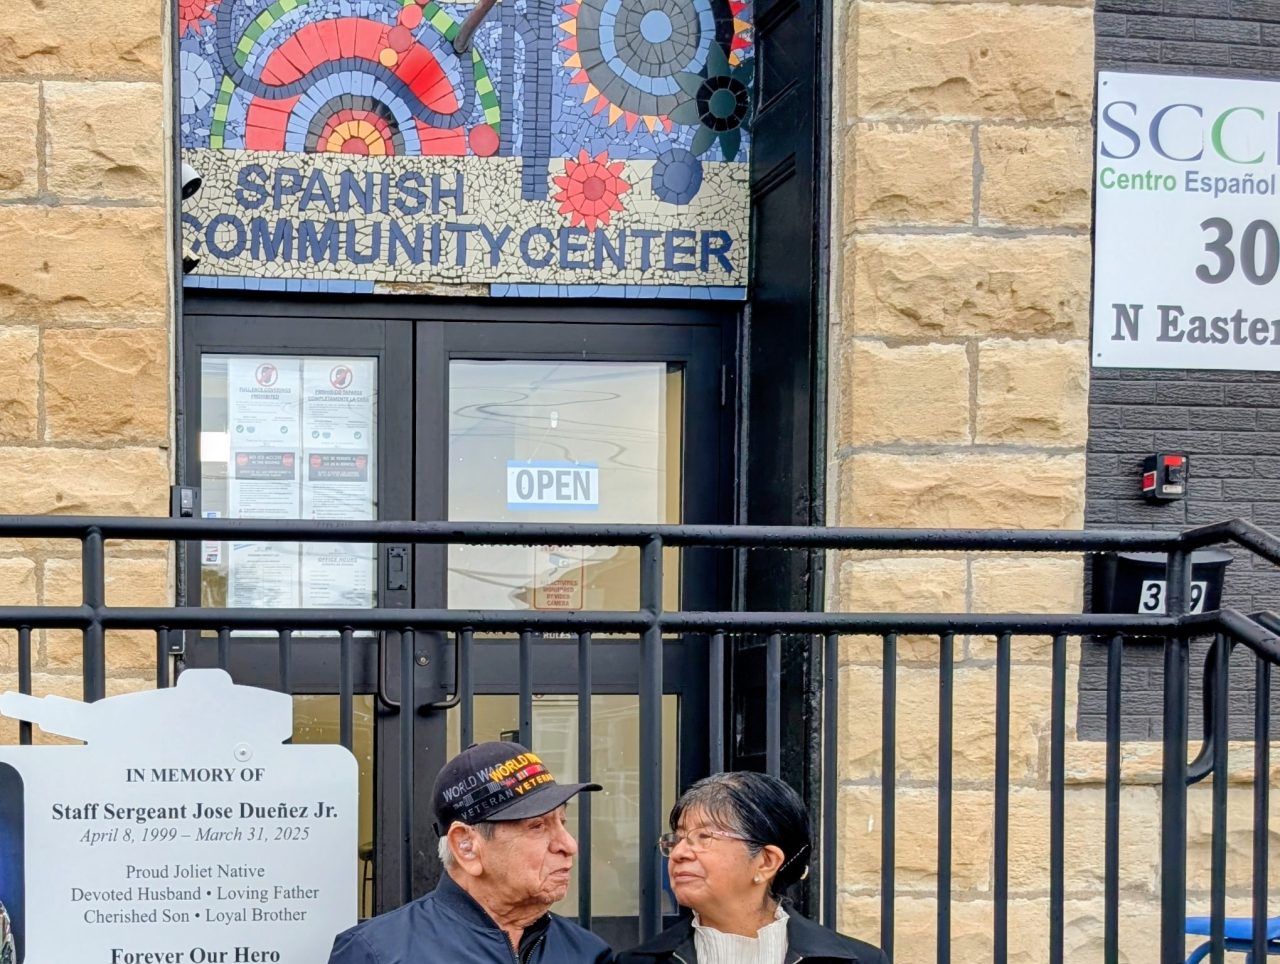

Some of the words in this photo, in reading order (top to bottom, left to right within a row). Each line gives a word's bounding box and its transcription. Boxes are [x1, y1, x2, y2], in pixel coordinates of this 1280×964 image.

[1100, 101, 1266, 164] SCC
[235, 164, 464, 216] SPANISH
[1099, 167, 1177, 191] Centro
[1185, 170, 1277, 198] Español
[520, 227, 734, 274] CENTER
[1111, 303, 1144, 341] N
[515, 469, 591, 501] OPEN
[1143, 583, 1203, 611] 39
[126, 768, 146, 782] IN
[150, 768, 236, 782] MEMORY
[240, 768, 266, 782] OF
[489, 754, 529, 783] WORLD
[442, 775, 477, 803] WORLD
[52, 803, 99, 820] Staff
[103, 803, 187, 824] Sergeant
[192, 803, 233, 819] Jose
[239, 802, 308, 819] Dueñez
[314, 801, 338, 818] Jr.
[461, 789, 514, 820] VETERAN
[79, 828, 119, 846] April
[122, 828, 135, 844] 8,
[142, 827, 177, 841] 1999
[194, 827, 242, 841] March
[247, 827, 268, 842] 31,
[274, 827, 310, 841] 2025
[126, 865, 169, 879] Proud
[173, 864, 213, 879] Joliet
[217, 864, 265, 878] Native
[71, 887, 133, 902] Devoted
[137, 886, 201, 901] Husband
[217, 885, 269, 904] Loving
[273, 885, 320, 899] Father
[83, 909, 157, 923] Cherished
[162, 908, 190, 922] Son
[205, 908, 247, 925] Loyal
[252, 907, 307, 921] Brother
[110, 948, 184, 964] Forever
[189, 947, 228, 964] Our
[233, 946, 281, 963] Hero
